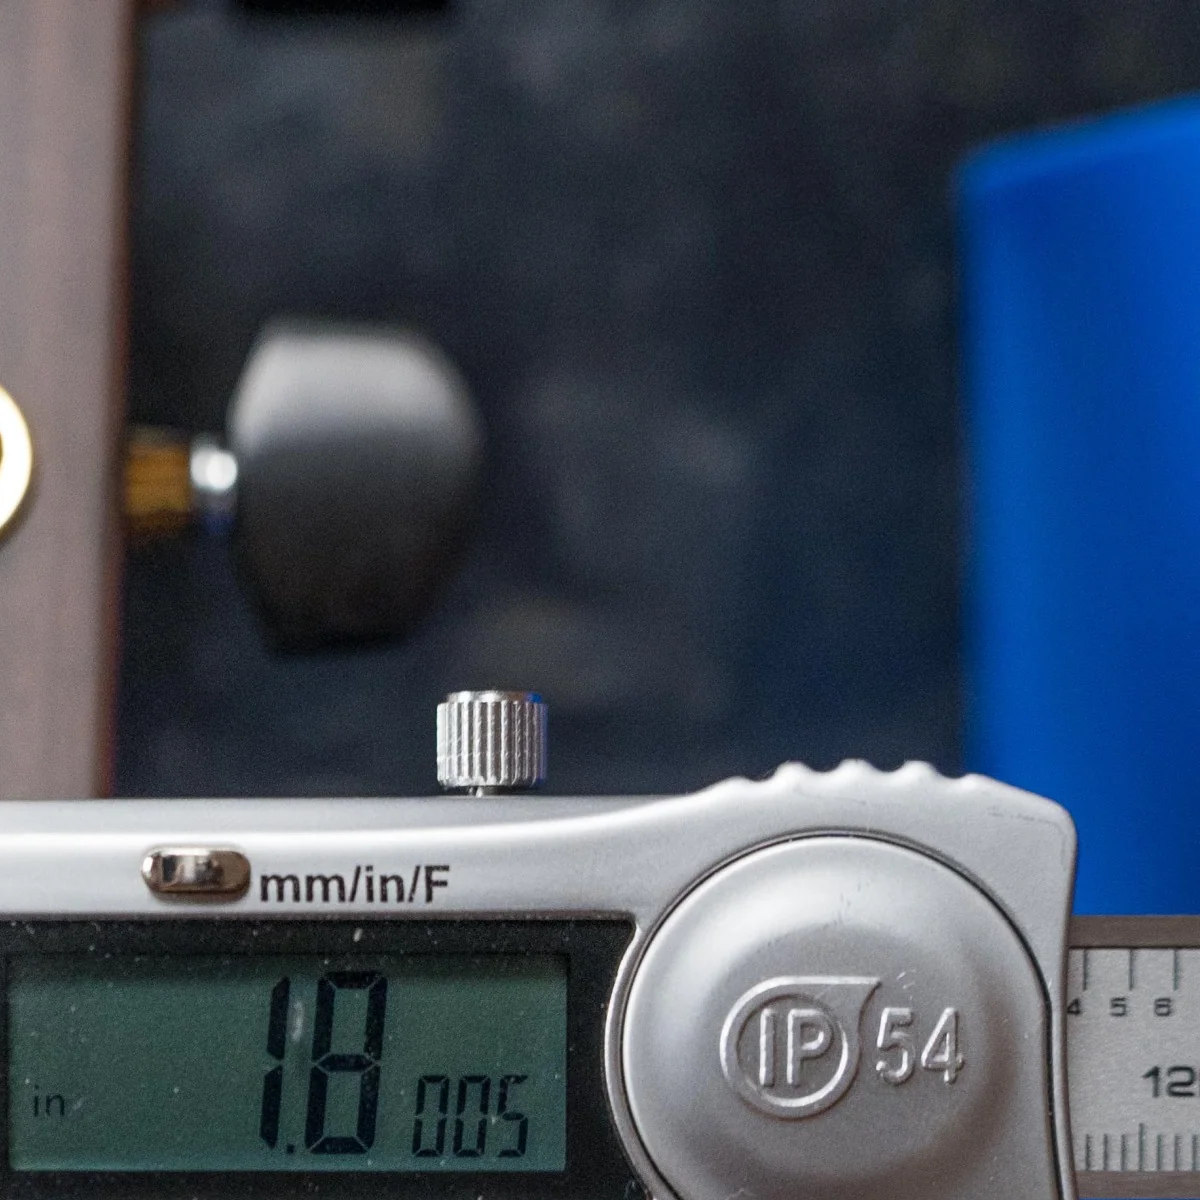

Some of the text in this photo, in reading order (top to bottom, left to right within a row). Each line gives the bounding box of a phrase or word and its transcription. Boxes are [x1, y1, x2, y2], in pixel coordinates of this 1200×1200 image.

[260, 865, 451, 904] mm/in/F
[1067, 997, 1173, 1017] 4 5 6
[758, 1006, 965, 1088] IP 54
[32, 1084, 67, 1119] in
